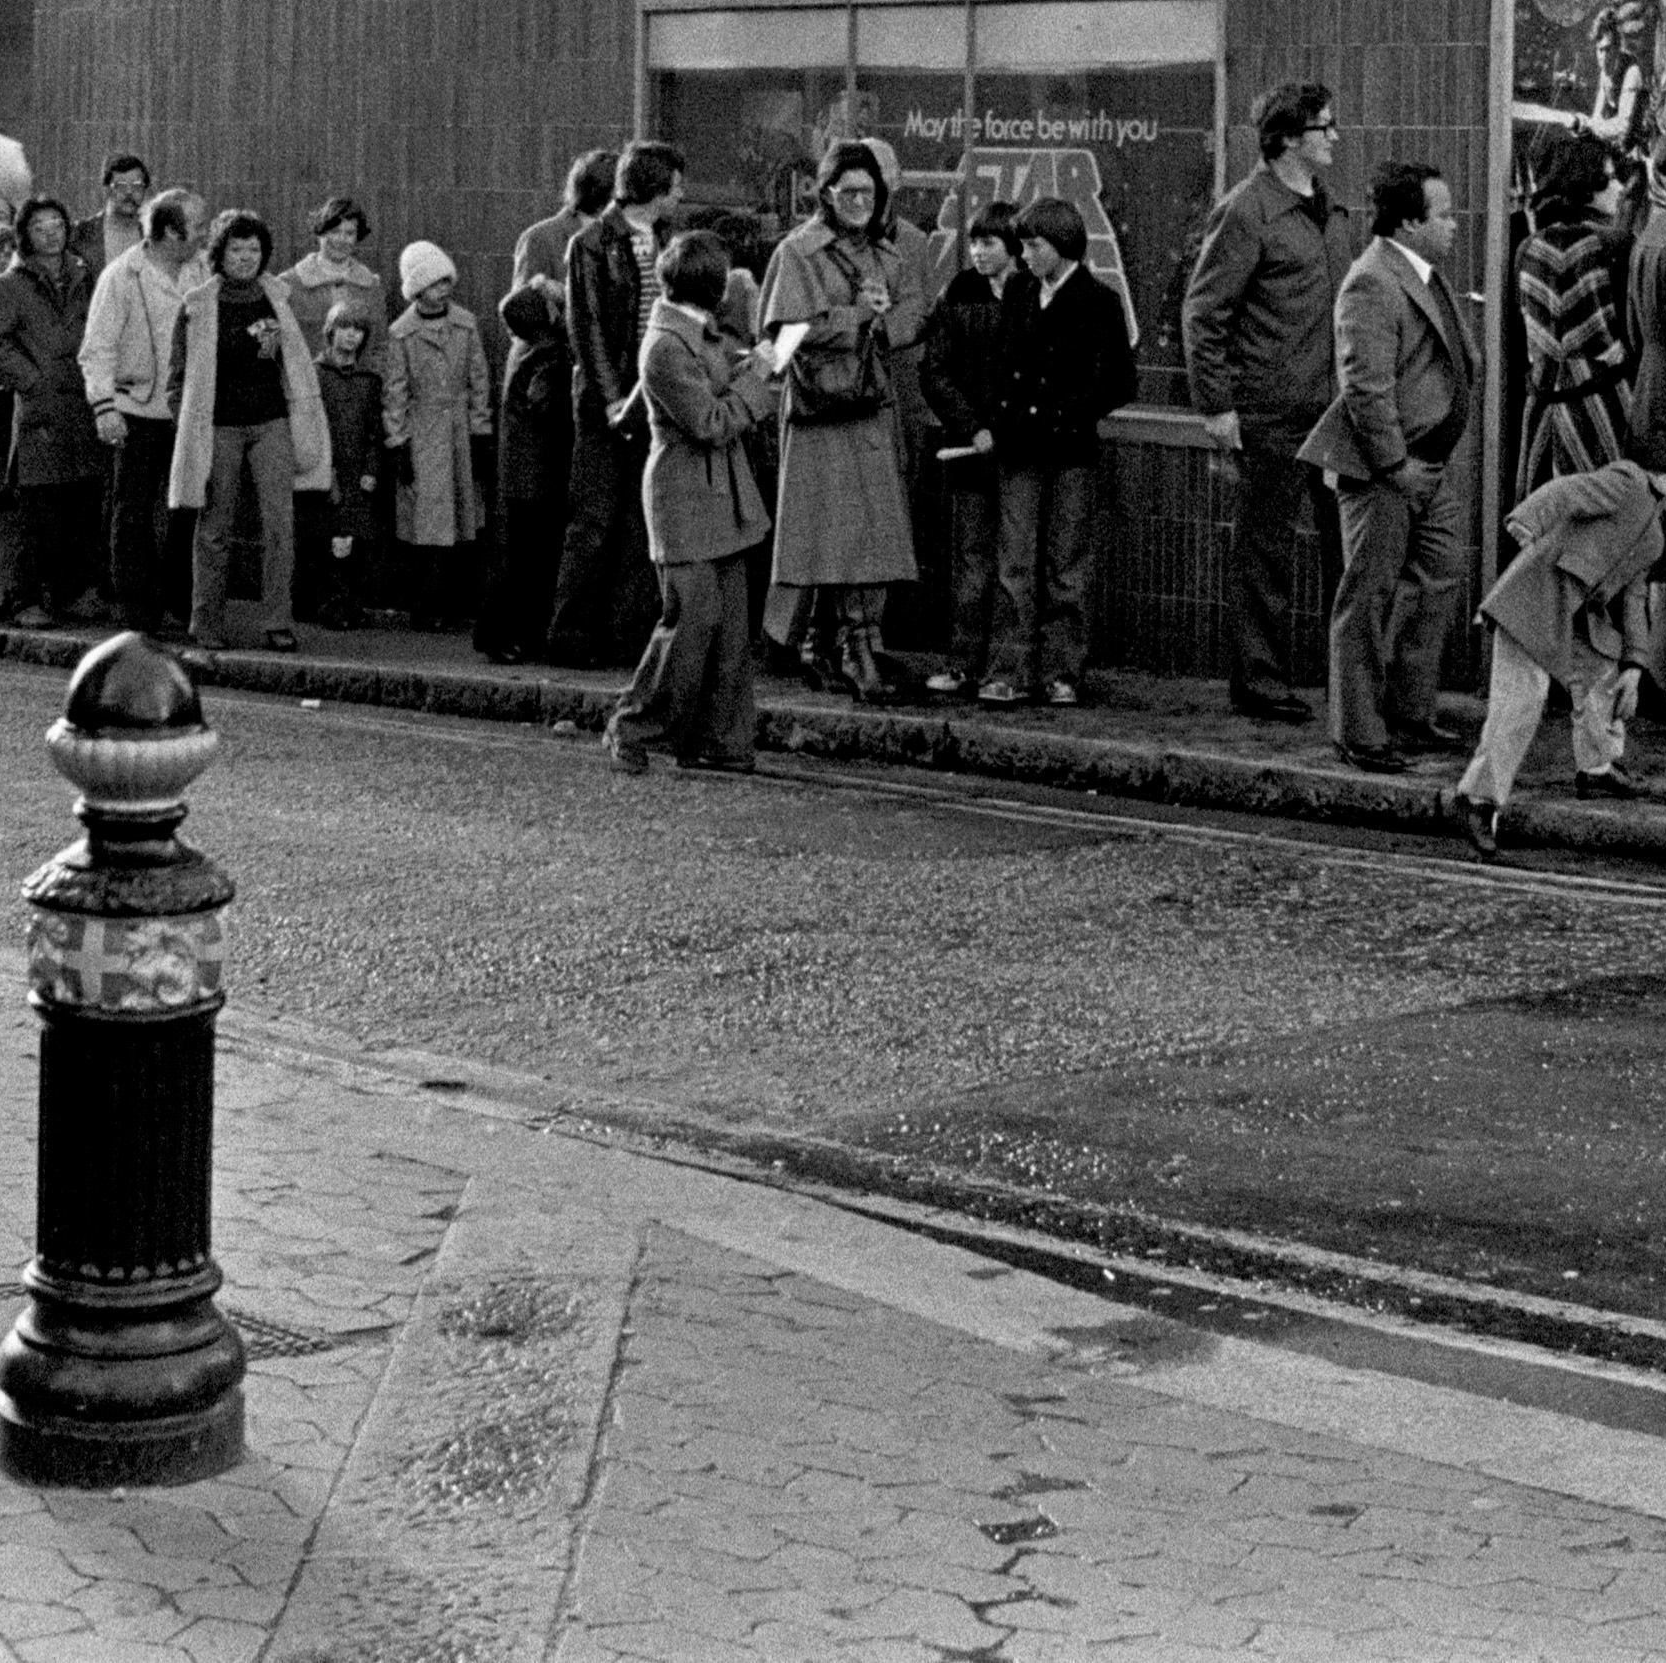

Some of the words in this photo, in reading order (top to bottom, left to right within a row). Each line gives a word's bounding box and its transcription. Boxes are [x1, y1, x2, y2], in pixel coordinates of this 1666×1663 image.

[904, 108, 946, 143] May
[949, 107, 983, 139] the
[984, 108, 1034, 141] force
[1038, 109, 1066, 141] be
[1069, 109, 1113, 142] with
[1116, 116, 1159, 149] you
